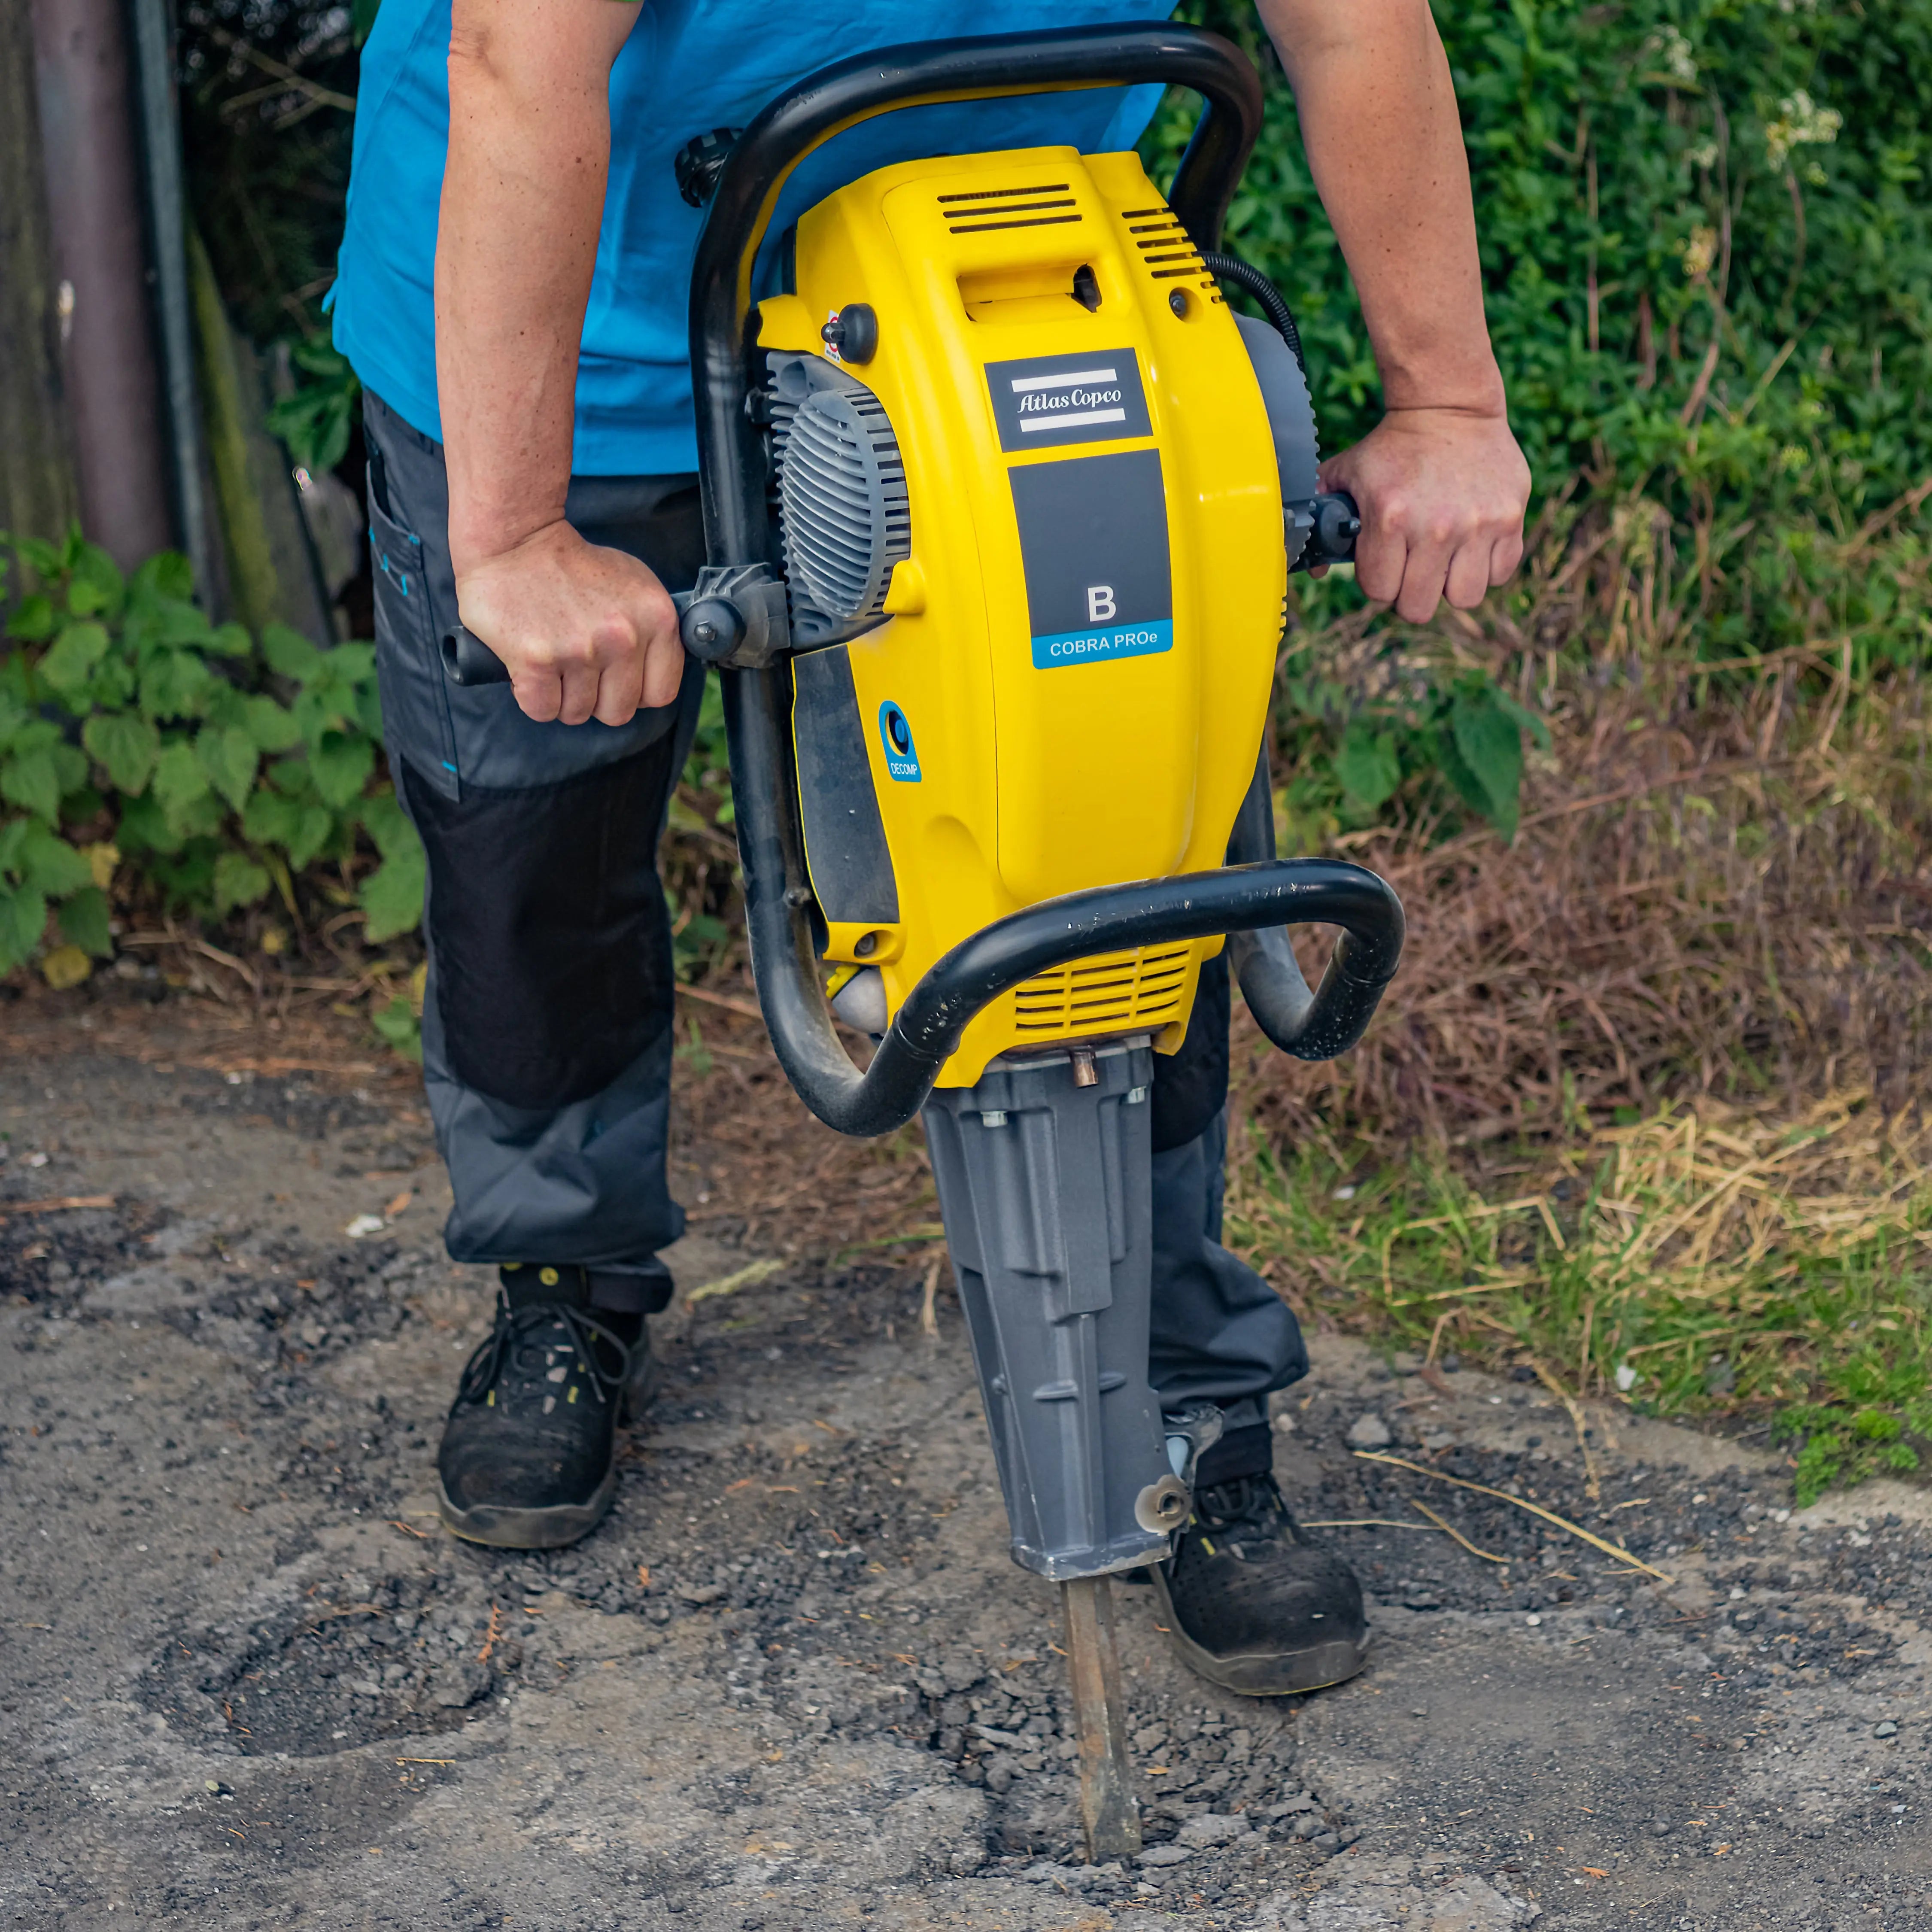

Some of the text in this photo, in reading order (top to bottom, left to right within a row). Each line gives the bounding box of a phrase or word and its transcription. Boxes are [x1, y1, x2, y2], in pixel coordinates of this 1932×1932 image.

[1017, 389, 1121, 413] Atlas Copco
[1088, 586, 1116, 622] B
[1050, 631, 1157, 656] COBRA PROe
[890, 763, 917, 775] DECOMP
